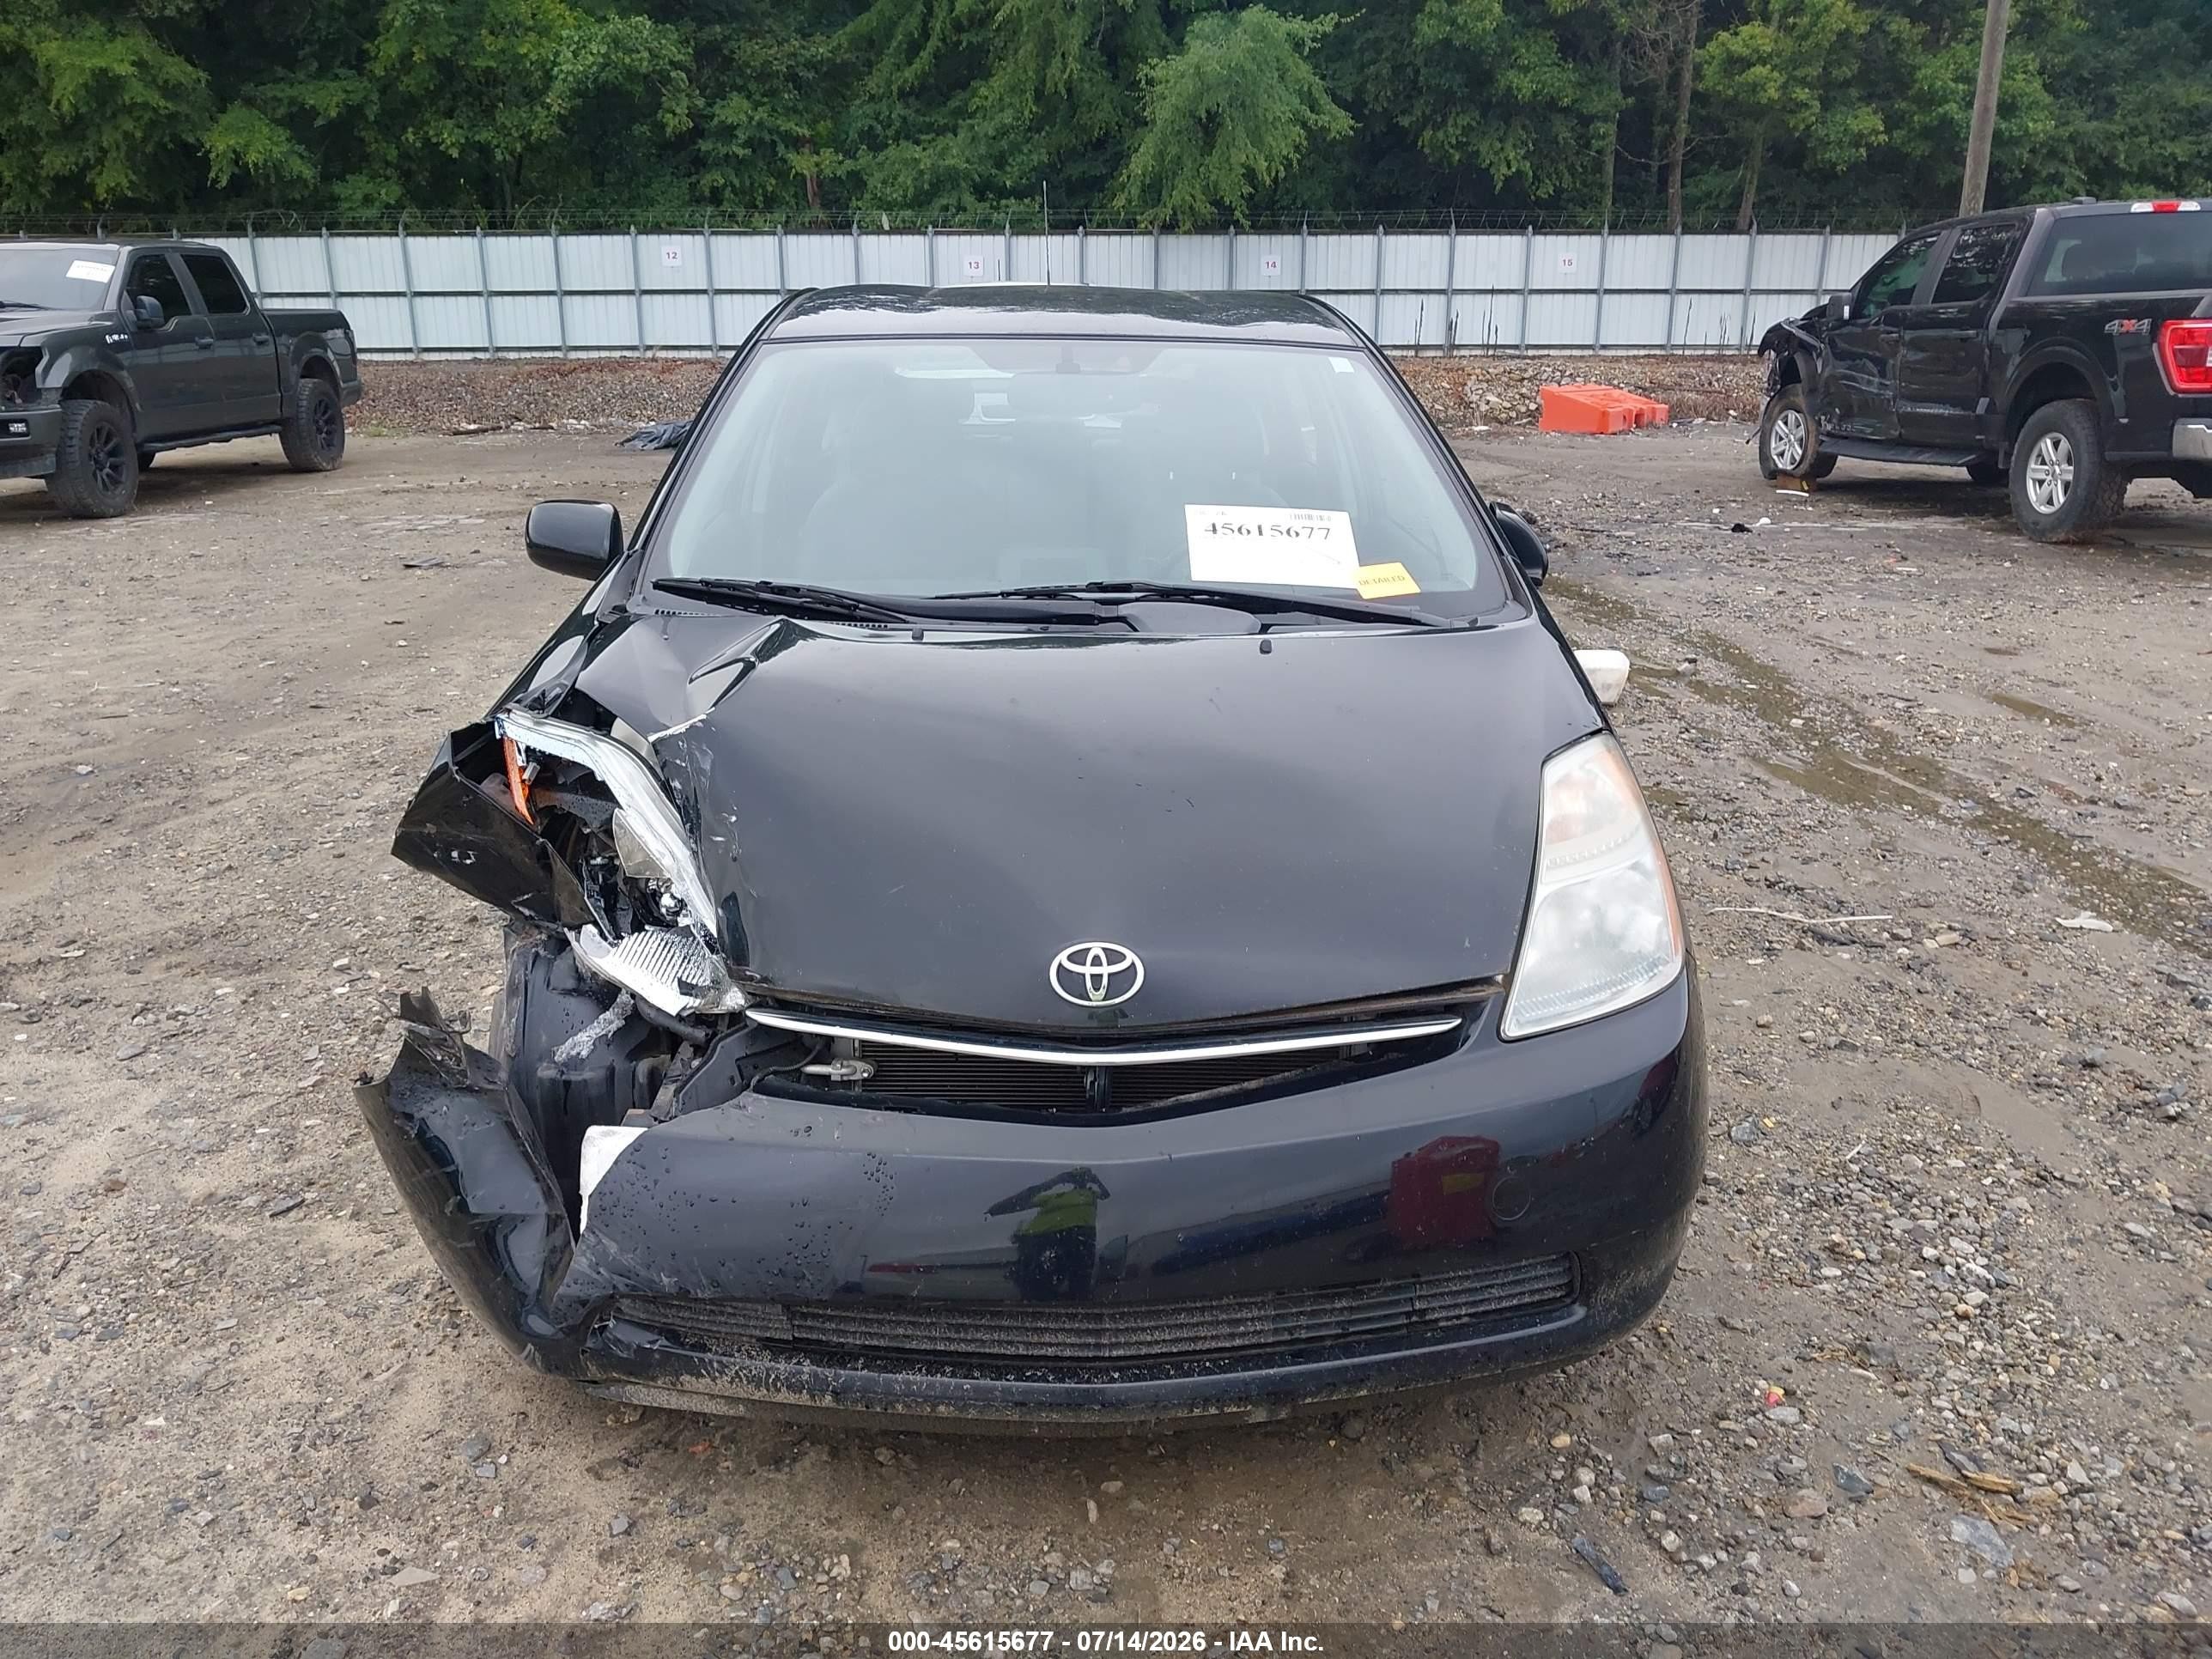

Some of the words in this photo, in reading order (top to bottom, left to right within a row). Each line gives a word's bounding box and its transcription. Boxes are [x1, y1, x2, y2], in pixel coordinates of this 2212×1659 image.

[665, 251, 678, 260] 12
[968, 261, 981, 270] 13
[1562, 258, 1574, 267] 15
[1204, 521, 1332, 541] 45615677
